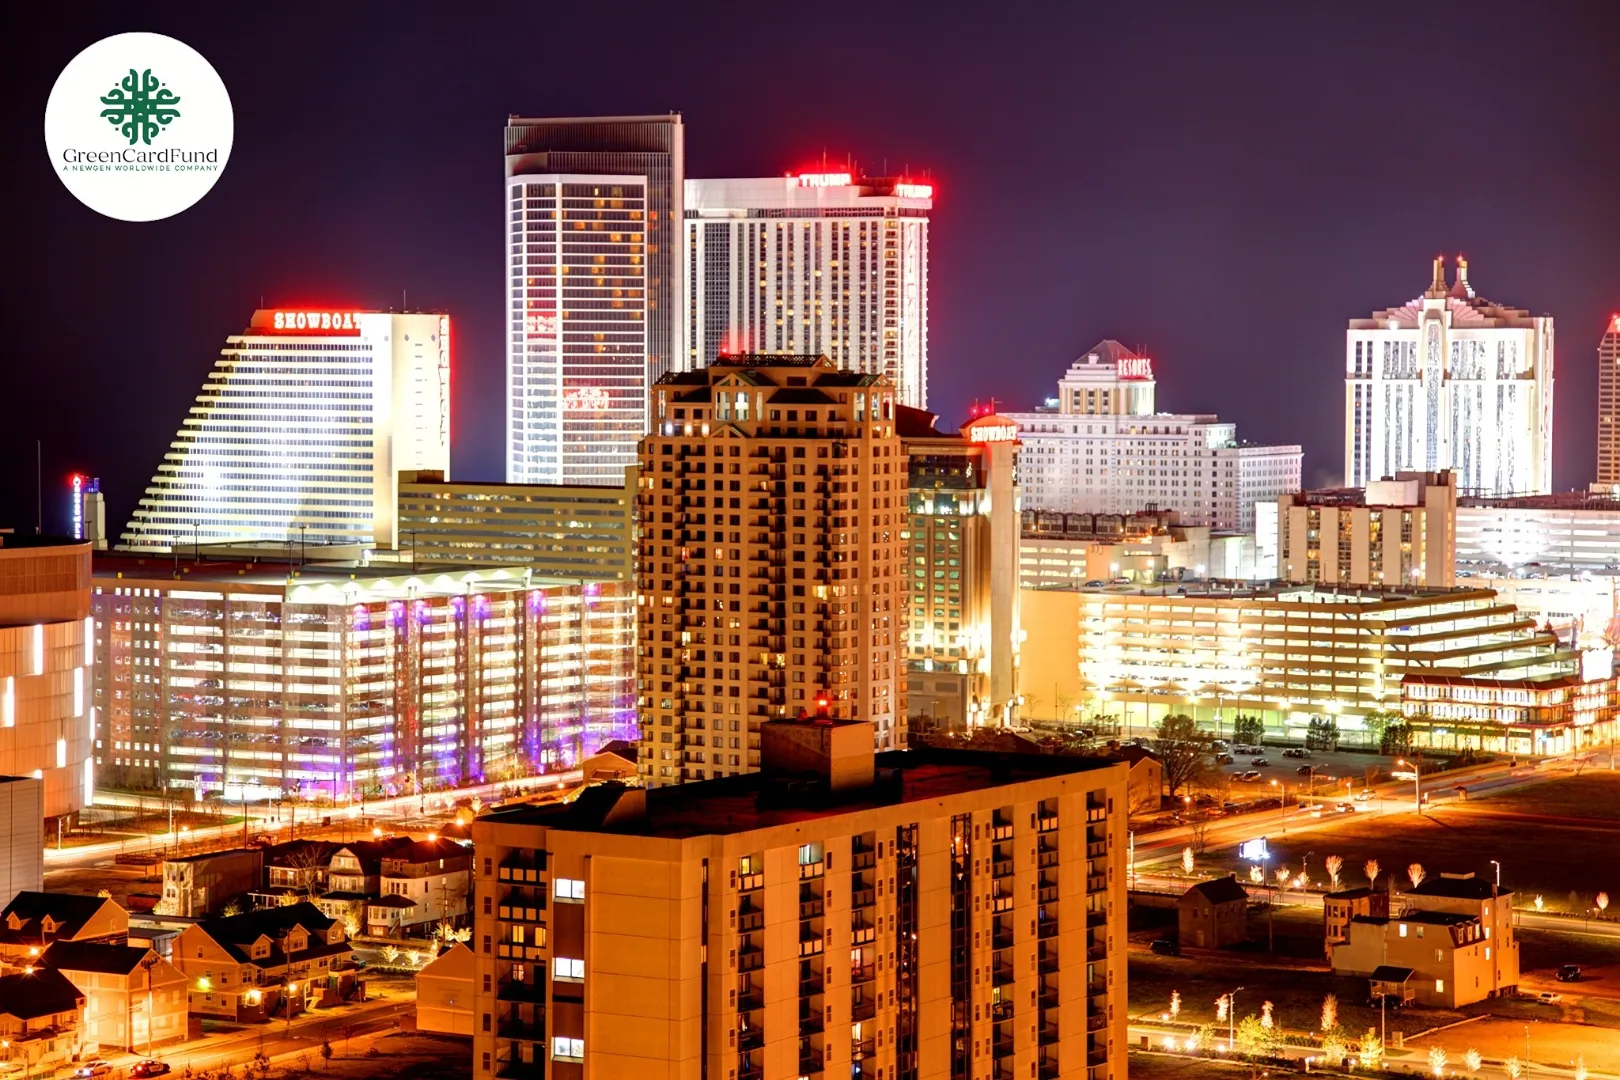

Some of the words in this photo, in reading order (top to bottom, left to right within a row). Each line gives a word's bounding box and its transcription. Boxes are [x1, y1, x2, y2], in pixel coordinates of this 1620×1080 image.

[799, 173, 851, 187] TRUMP
[896, 184, 933, 199] TRUMP
[274, 311, 362, 330] SHOWBOAT
[1117, 358, 1152, 376] RESORTS
